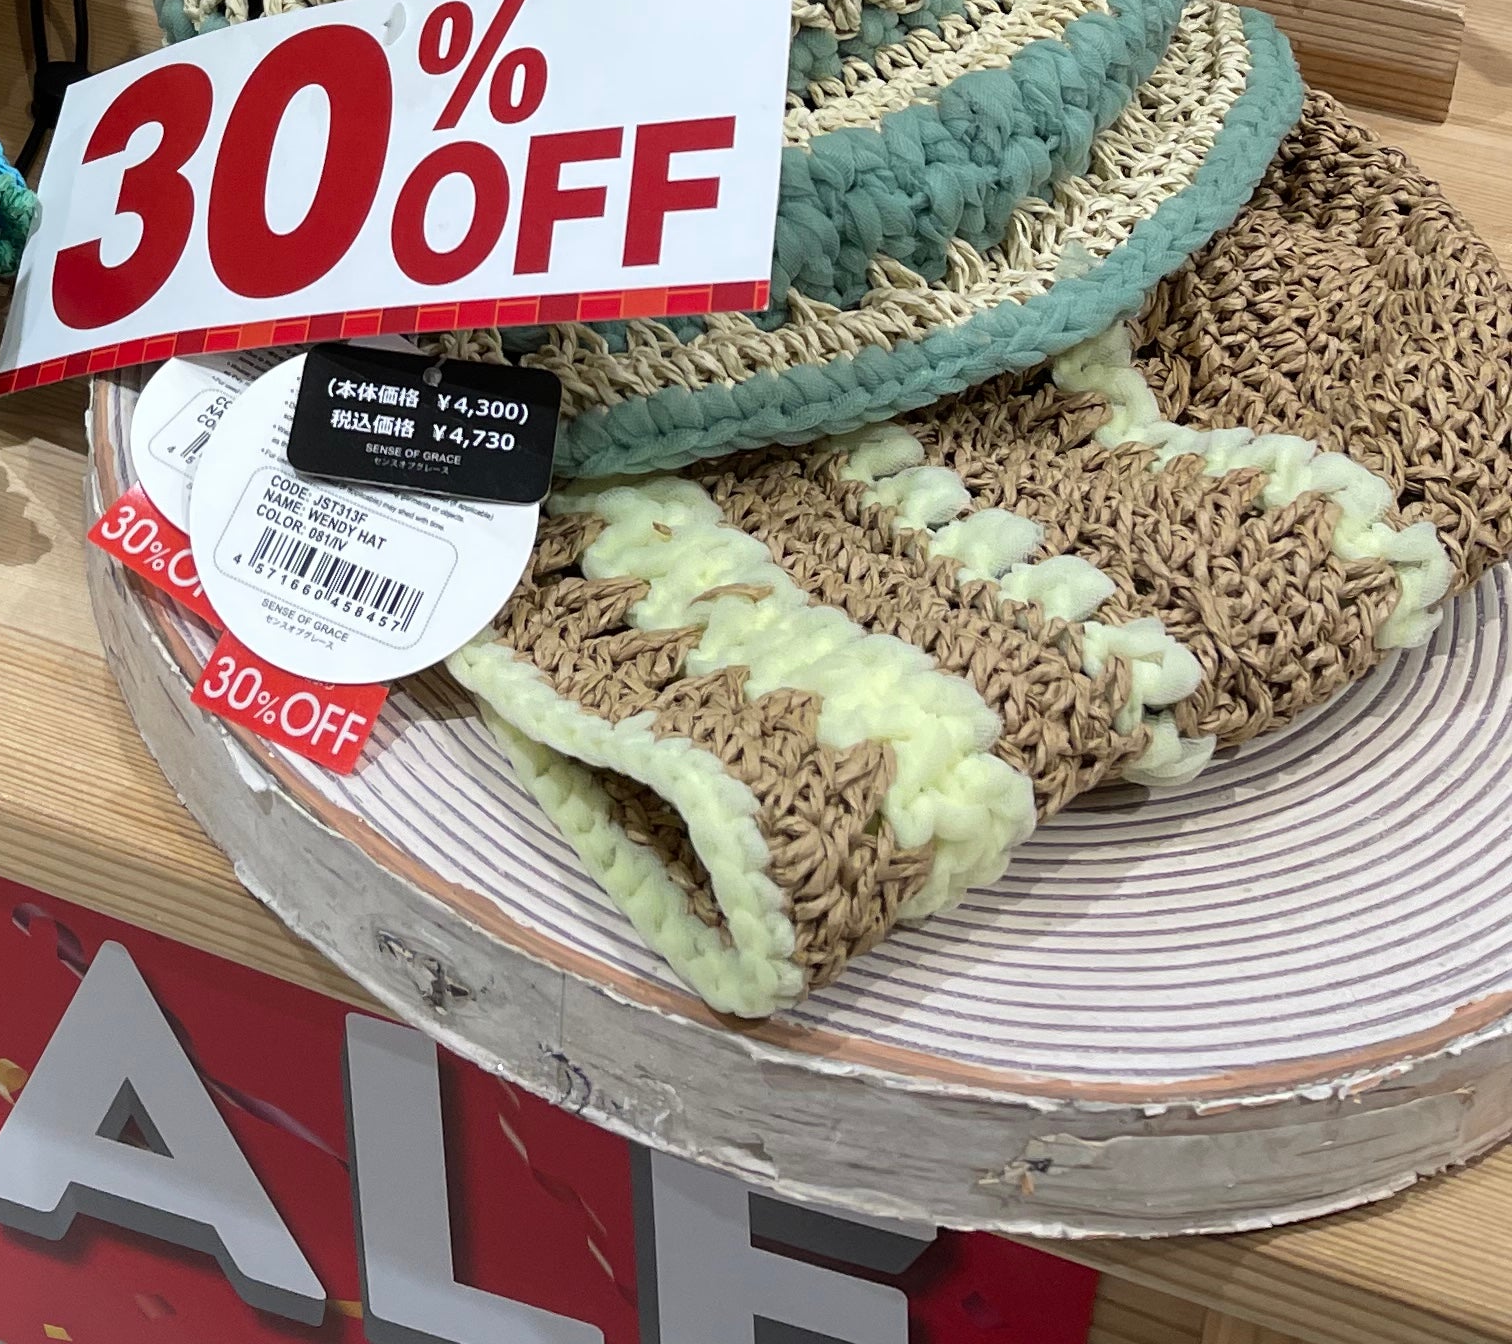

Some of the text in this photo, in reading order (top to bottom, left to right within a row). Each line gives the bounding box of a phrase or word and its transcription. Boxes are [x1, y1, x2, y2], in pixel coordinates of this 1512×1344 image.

[391, 115, 736, 286] OFF
[327, 377, 529, 425] (本体価格 ¥4,300)
[330, 408, 516, 451] 税込価格 ¥4,730
[365, 442, 462, 466] SENSE OF GRACE
[263, 487, 387, 550] NAME: WENDY HAT
[271, 474, 368, 525] CODE: JST313F
[256, 503, 348, 552] COLOR: 081/IV
[254, 562, 324, 601] 571660
[330, 597, 401, 632] 458457
[261, 598, 349, 642] SENSE OF GRACE
[266, 614, 334, 650] センスオブグレース
